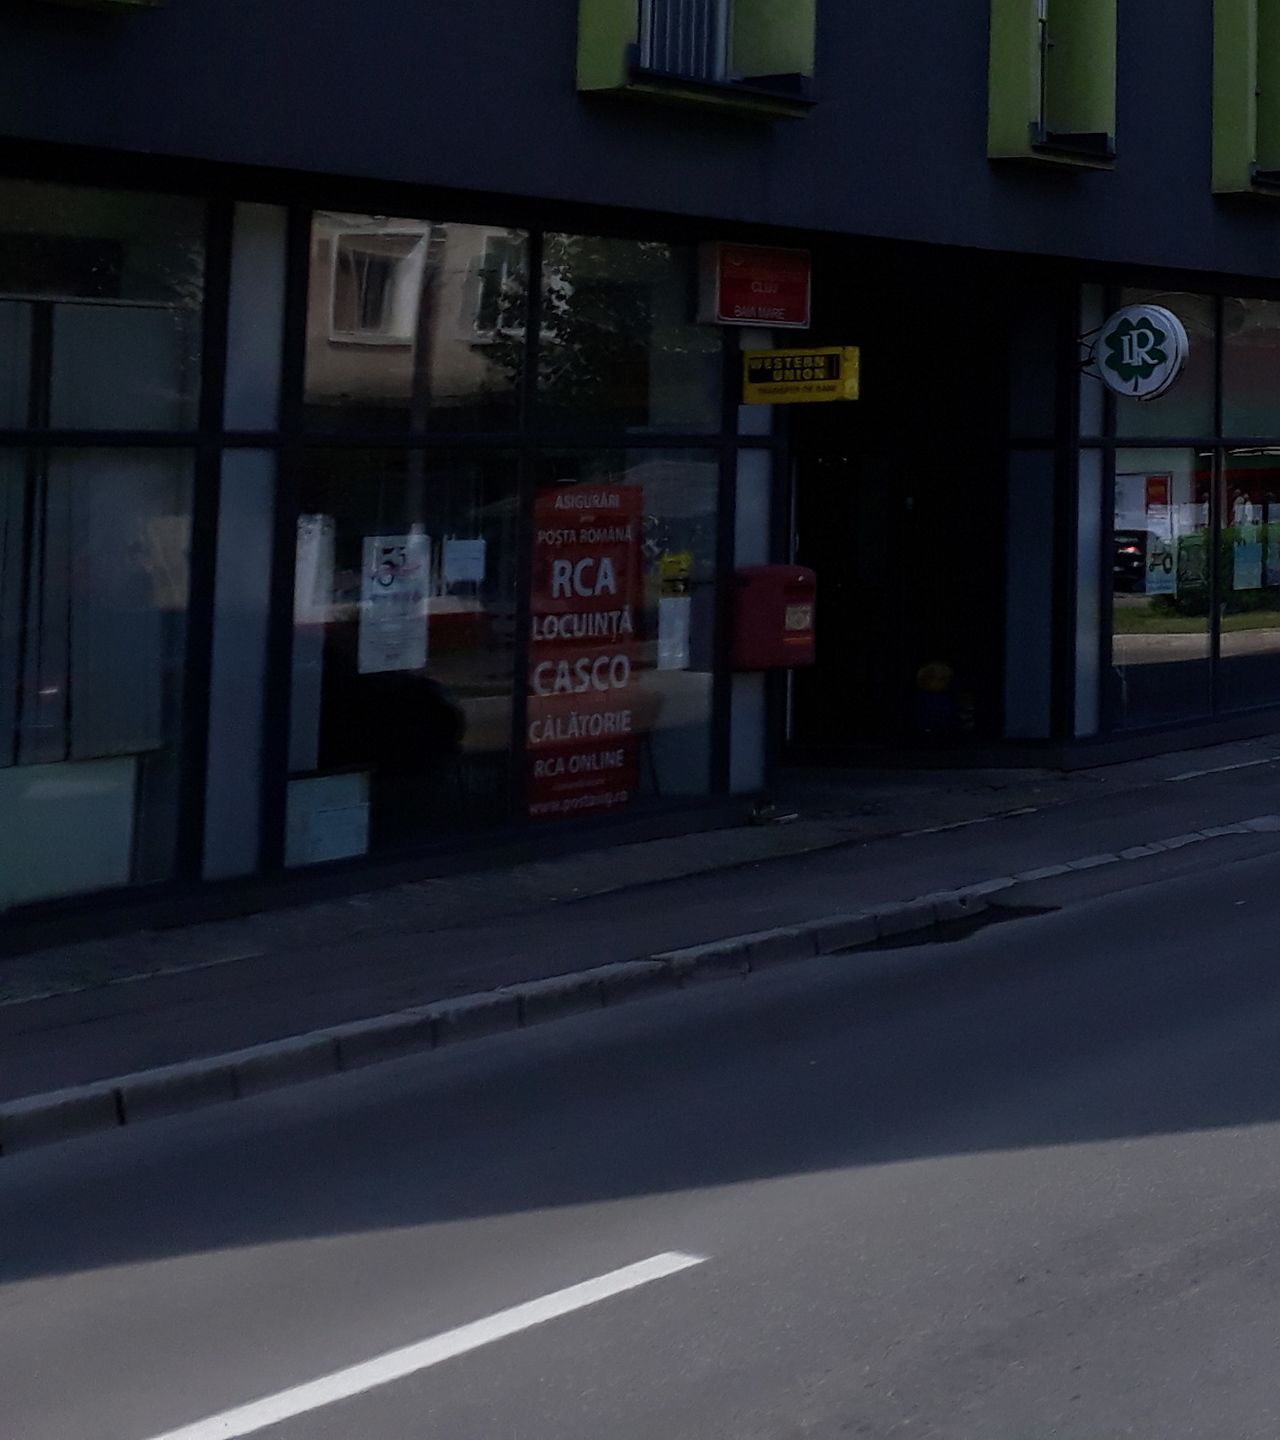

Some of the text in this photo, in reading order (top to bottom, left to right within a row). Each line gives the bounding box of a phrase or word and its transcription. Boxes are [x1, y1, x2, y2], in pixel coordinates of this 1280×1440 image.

[750, 357, 826, 371] WESTERN
[771, 368, 826, 381] UNION
[551, 557, 618, 599] RCA
[532, 603, 634, 644] LOCUINȚĂ
[532, 655, 632, 695] CASCO
[529, 710, 633, 744] CĂLĂTORIE
[534, 749, 626, 779] RCA ONLINE
